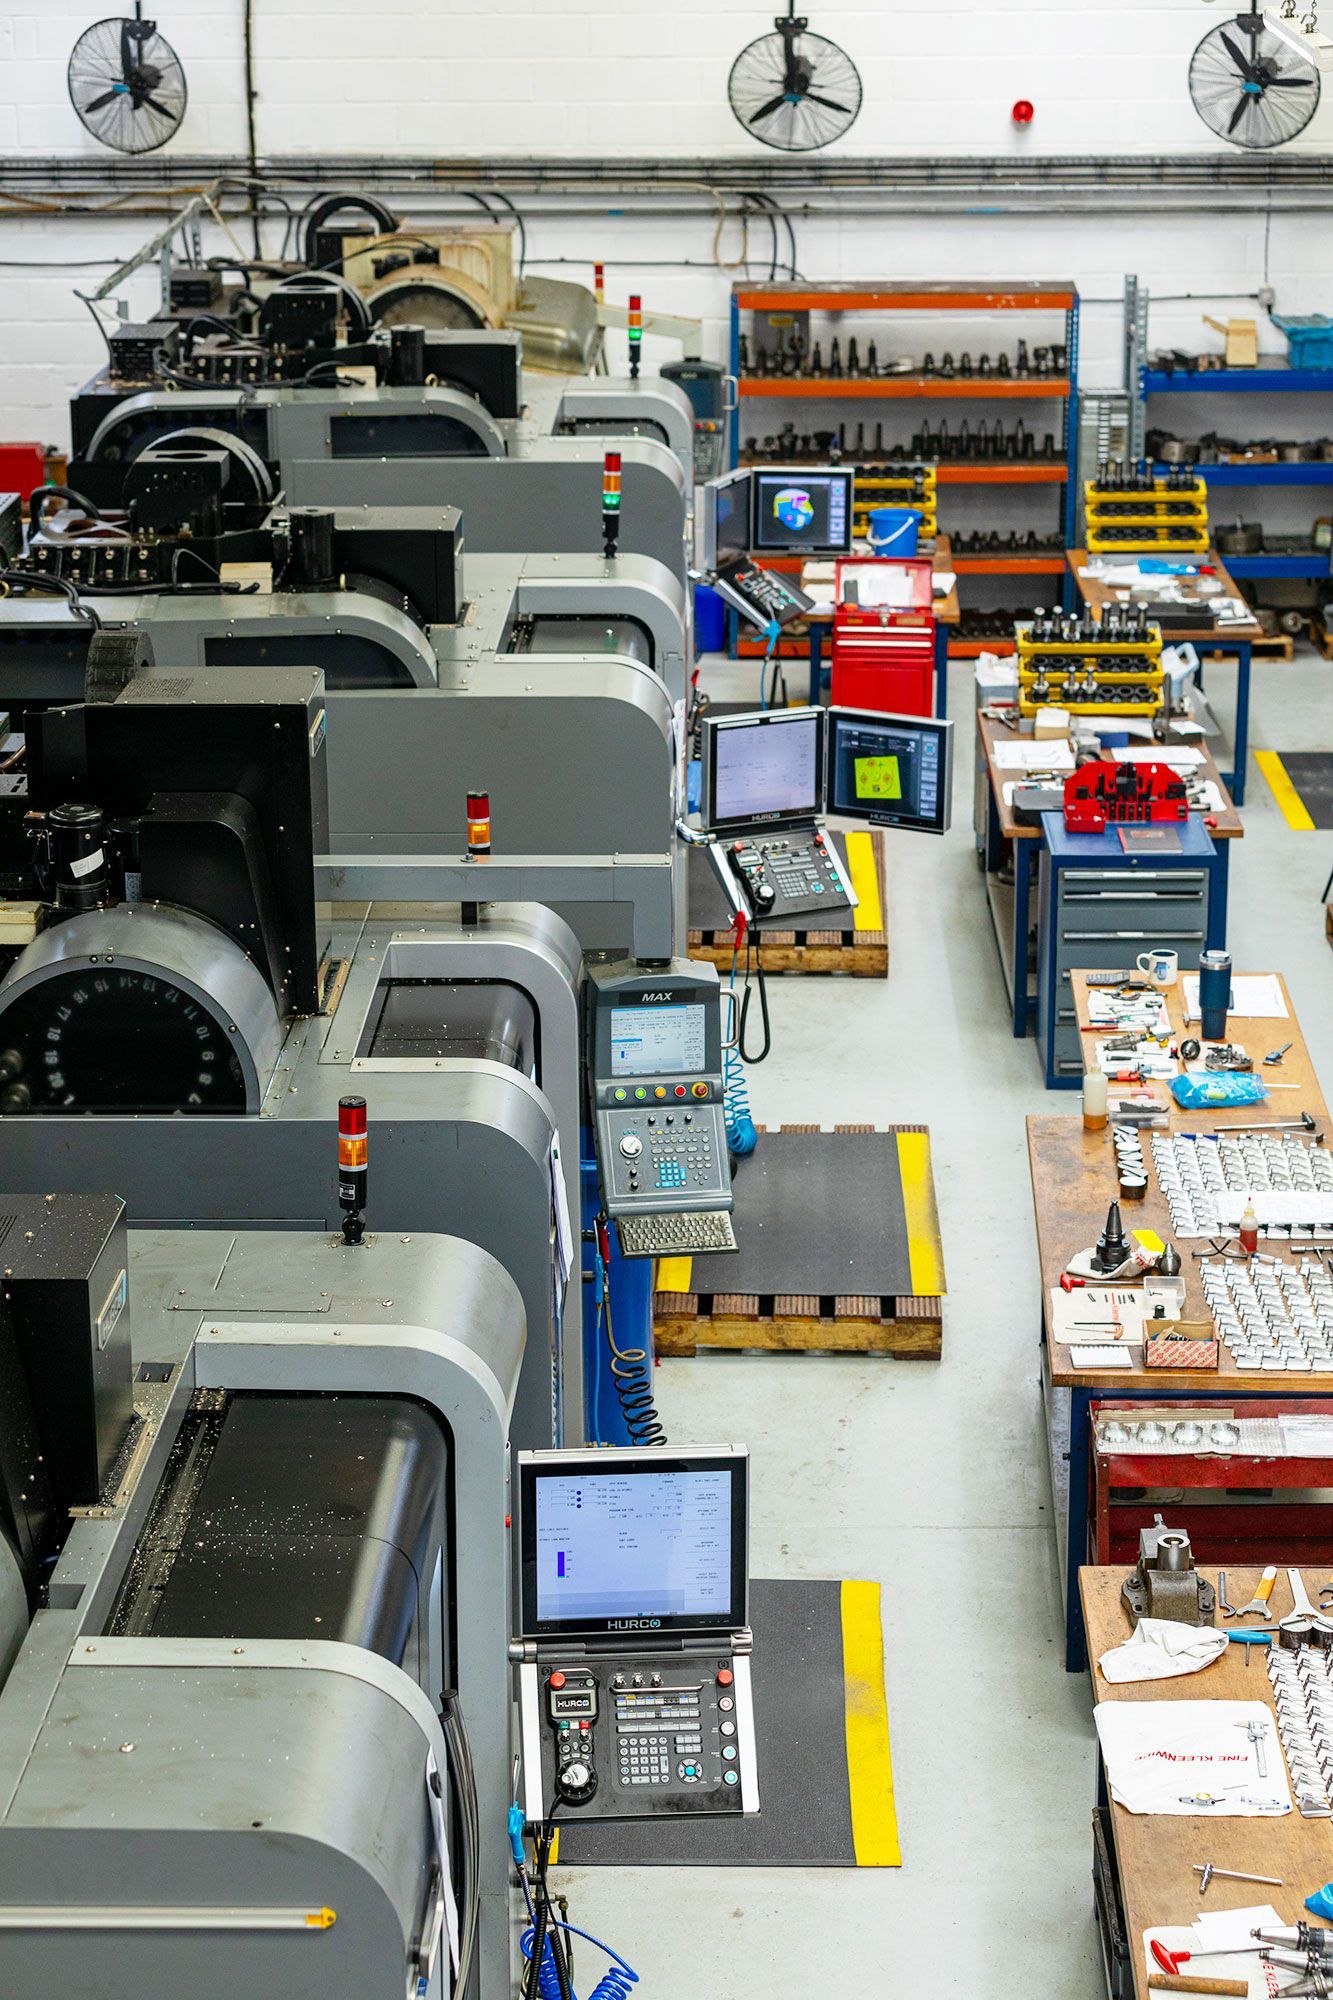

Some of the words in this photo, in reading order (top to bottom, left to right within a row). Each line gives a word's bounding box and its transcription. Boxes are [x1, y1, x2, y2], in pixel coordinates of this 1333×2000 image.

[94, 979, 110, 992] 15
[143, 979, 156, 992] 13
[73, 989, 88, 1004] 16
[165, 988, 179, 1003] 12
[641, 992, 673, 1002] MAX
[56, 1006, 72, 1021] 17
[183, 1005, 198, 1020] 11
[47, 1027, 61, 1041] 18
[196, 1026, 210, 1040] 10
[44, 1050, 58, 1065] 19
[48, 1072, 65, 1088] 20
[199, 1073, 213, 1085] 8
[607, 1619, 661, 1630] HURCO
[557, 1699, 589, 1708] HURCO
